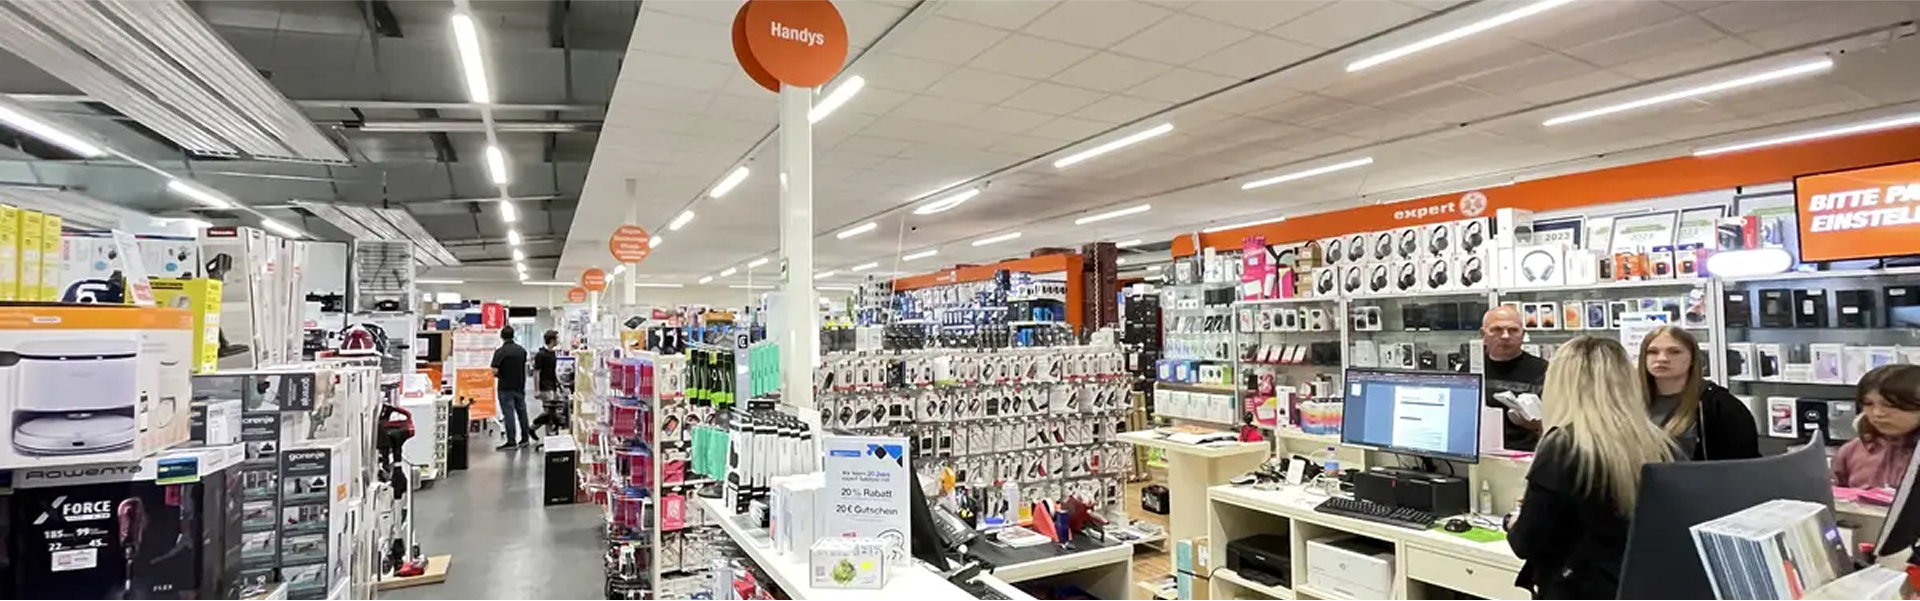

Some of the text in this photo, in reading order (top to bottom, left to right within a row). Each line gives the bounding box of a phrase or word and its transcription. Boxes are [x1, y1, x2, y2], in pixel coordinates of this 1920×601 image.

[771, 21, 824, 46] Handys
[1808, 187, 1880, 212] BITTE
[1393, 202, 1456, 220] expert
[288, 451, 326, 462] gorenje
[841, 488, 851, 497] 20
[863, 488, 893, 498] Rabatt
[63, 500, 111, 515] FORCE
[854, 505, 899, 516] Gutschein
[48, 542, 62, 552] 22
